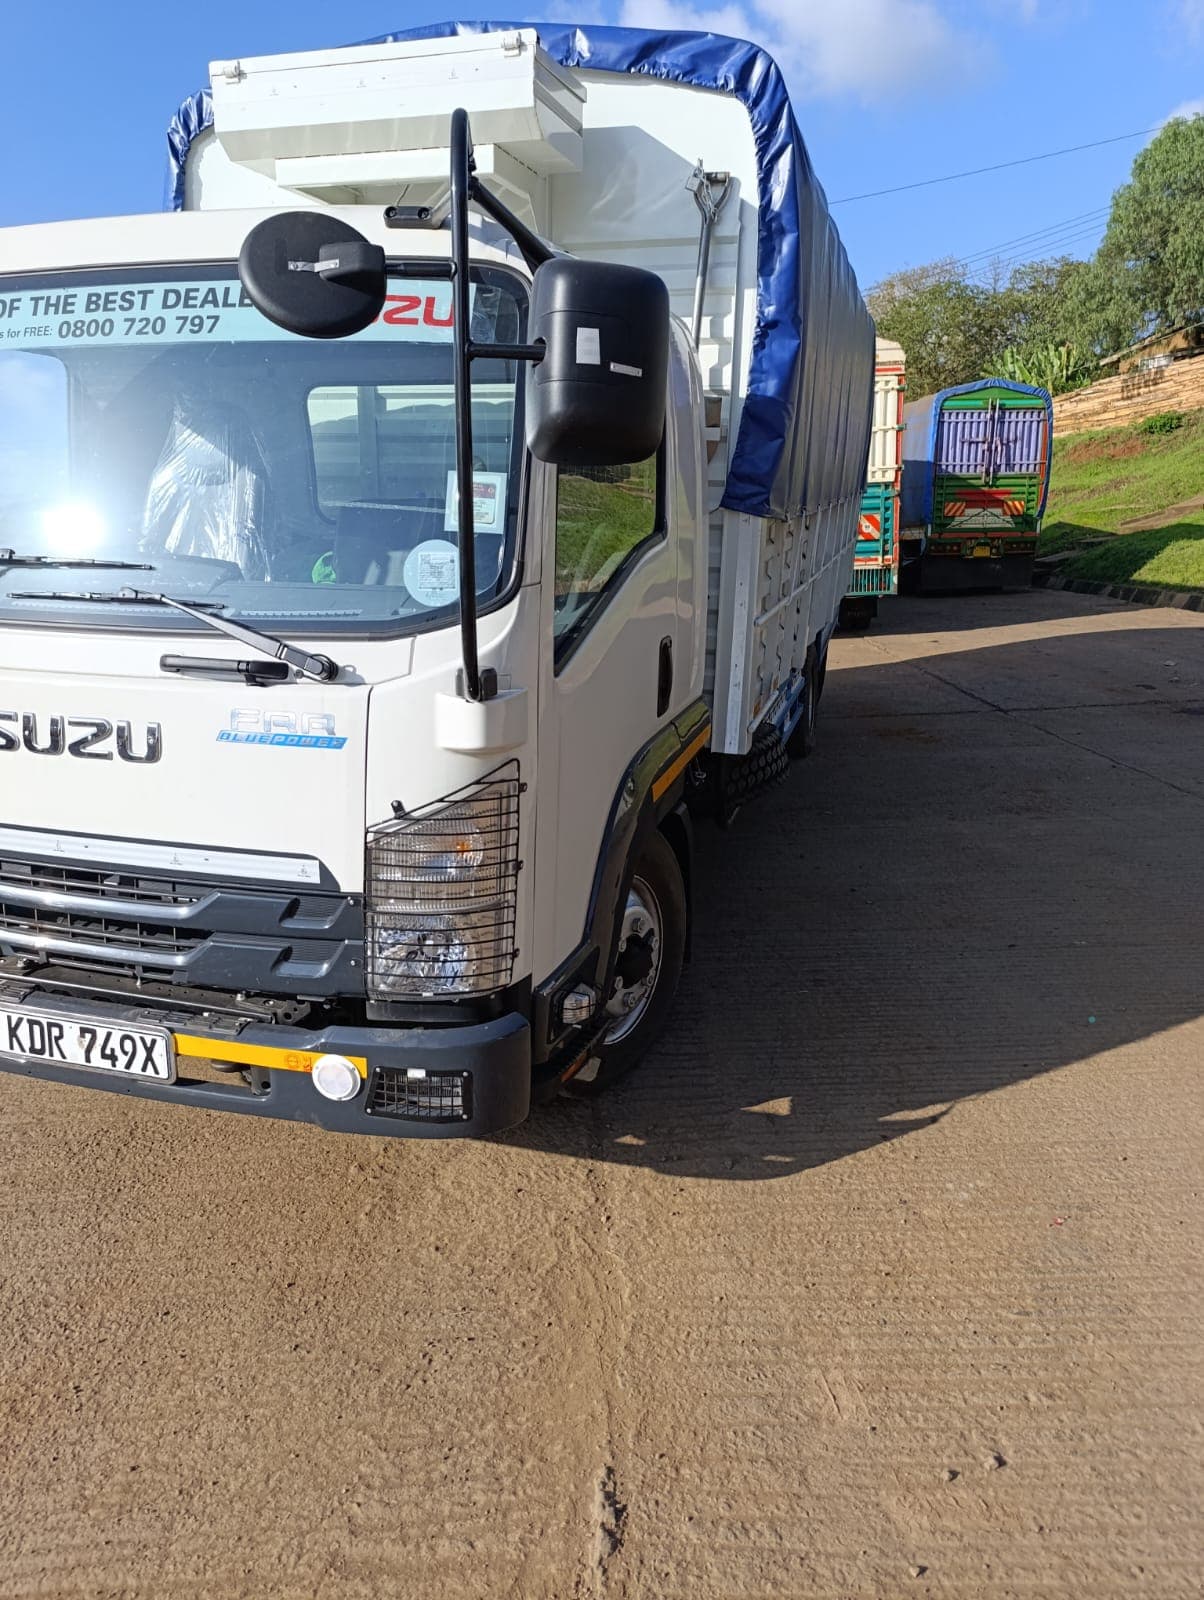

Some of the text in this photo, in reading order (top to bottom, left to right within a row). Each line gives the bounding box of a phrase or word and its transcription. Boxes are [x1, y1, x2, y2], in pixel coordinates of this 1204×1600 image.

[30, 293, 78, 317] THE
[85, 289, 154, 313] BEST
[373, 294, 454, 327] ZU
[7, 328, 21, 339] for
[23, 325, 53, 338] FREE:
[58, 318, 115, 339] 0800
[123, 316, 166, 336] 720
[175, 314, 220, 335] 797
[230, 706, 336, 737] FRR
[217, 731, 347, 750] BLUEPOWER
[7, 1014, 160, 1076] KDR 749X
